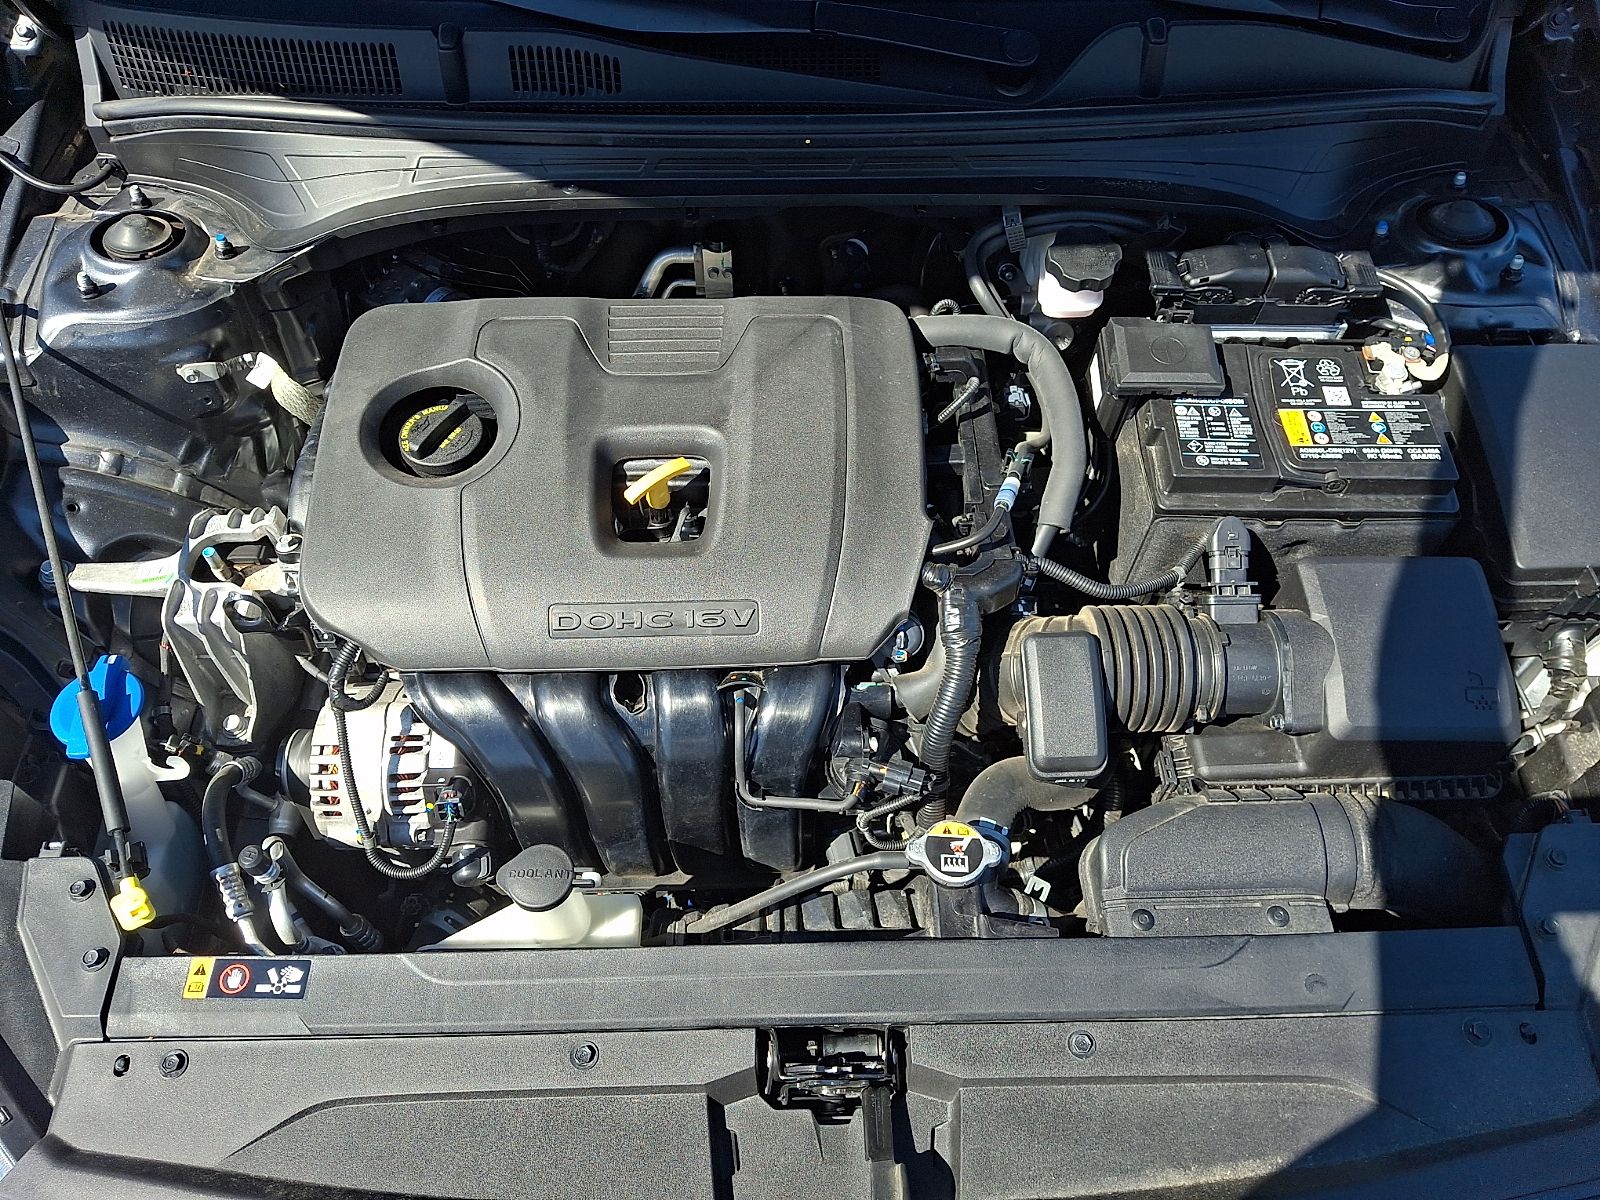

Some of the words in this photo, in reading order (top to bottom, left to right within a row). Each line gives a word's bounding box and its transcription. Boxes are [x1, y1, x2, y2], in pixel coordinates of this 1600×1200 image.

[1290, 386, 1309, 396] Pb
[401, 414, 421, 439] OWNER'S
[401, 440, 410, 452] SEE
[552, 611, 674, 631] DOHC
[685, 608, 756, 629] 16V
[509, 868, 573, 880] COOLANT
